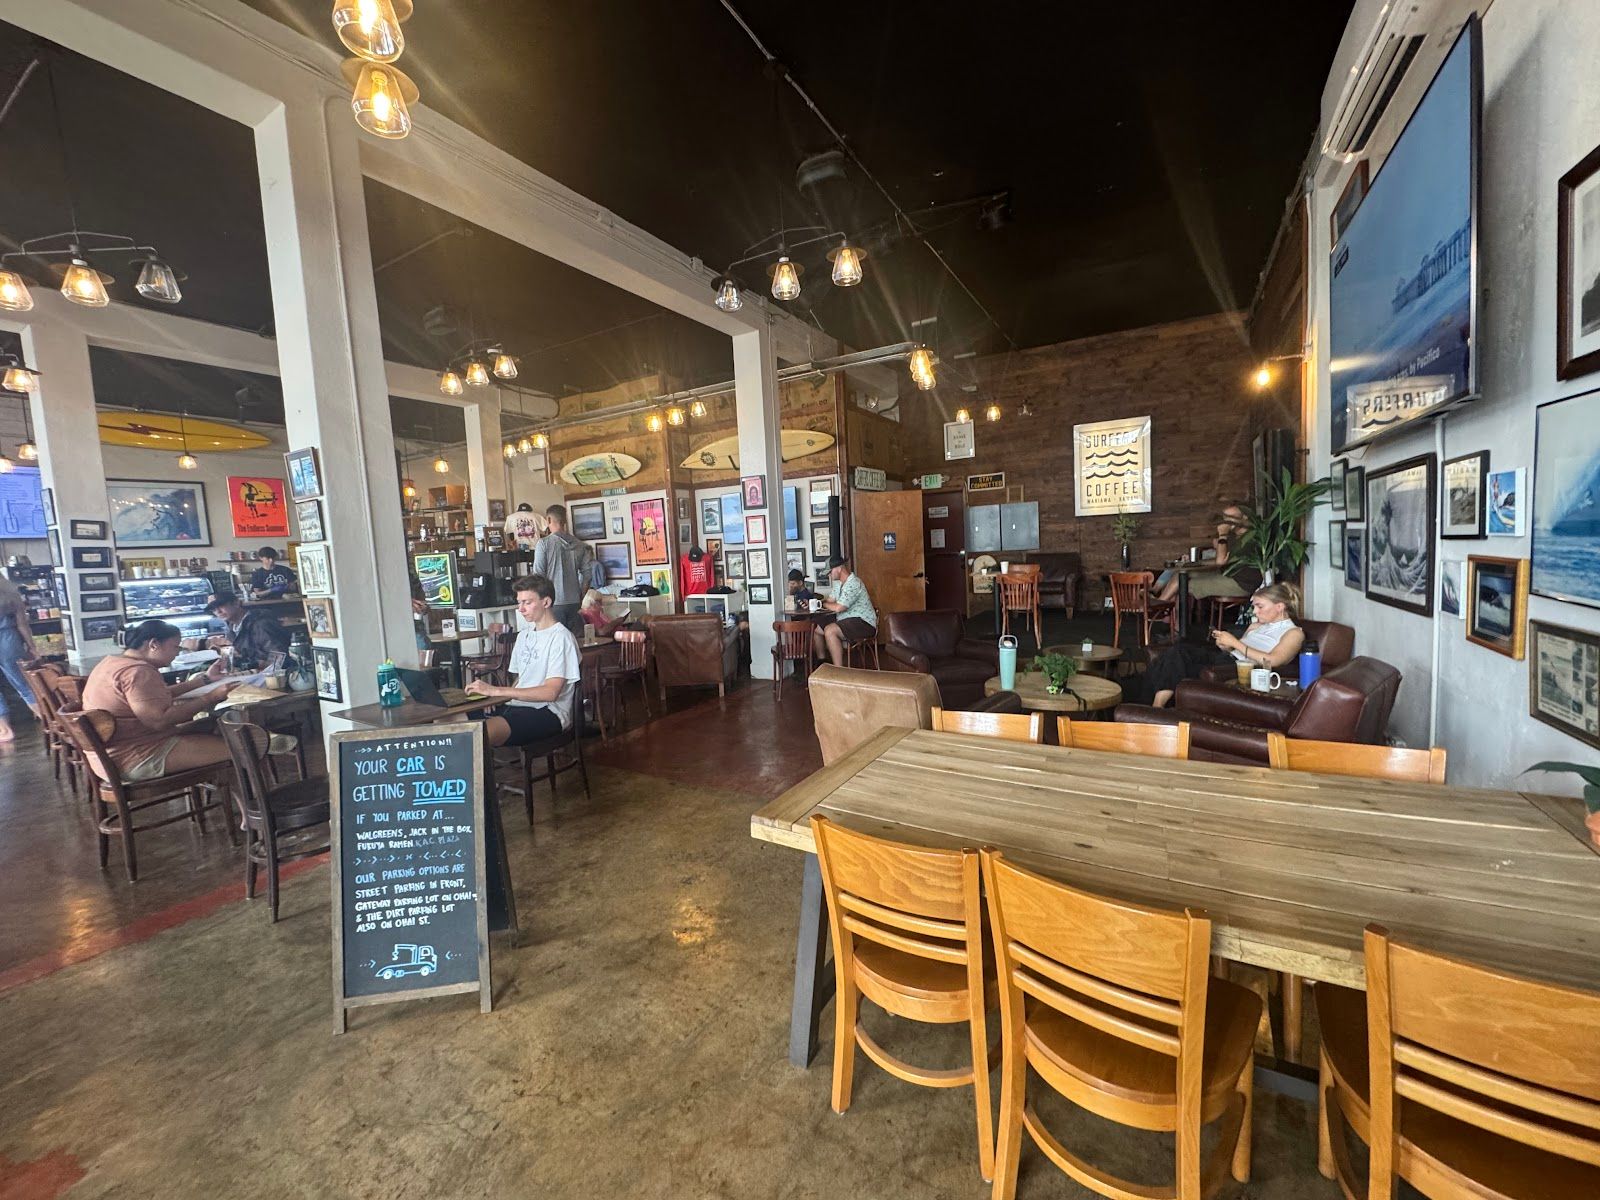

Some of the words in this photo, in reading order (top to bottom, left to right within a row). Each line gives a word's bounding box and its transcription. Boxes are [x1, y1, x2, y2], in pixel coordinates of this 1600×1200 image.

[924, 476, 938, 487] EXIT
[971, 480, 1003, 489] COMMITTED
[1086, 481, 1138, 497] COFFEE
[376, 738, 452, 752] ATTENTION!!
[354, 758, 388, 775] YOUR
[396, 756, 425, 772] CAR
[434, 755, 446, 771] IS
[352, 783, 405, 802] GETTING
[412, 779, 467, 798] TOWED
[356, 814, 366, 824] IF
[373, 813, 389, 822] YOU
[397, 810, 427, 821] PARKED
[409, 827, 427, 837] JACK
[442, 825, 455, 833] THE
[355, 872, 377, 884] OUR
[382, 867, 415, 880] PARKING
[418, 865, 450, 876] OPTIONS
[451, 864, 466, 874] ARE
[355, 886, 388, 899] STREET
[394, 881, 426, 894] PARKING
[429, 880, 437, 888] IN
[355, 899, 391, 911] GATEWAY
[394, 896, 423, 907] PARKING
[425, 894, 440, 903] LOT
[441, 893, 452, 901] ON
[453, 891, 472, 901] OHAI
[356, 914, 362, 922] &
[366, 911, 383, 922] THE
[386, 908, 406, 919] DIRT
[408, 905, 438, 916] PARKING
[441, 904, 455, 913] LOT
[356, 922, 376, 933] ALSO
[380, 920, 392, 929] ON
[395, 917, 415, 927] OHAI
[418, 915, 431, 925] ST.
